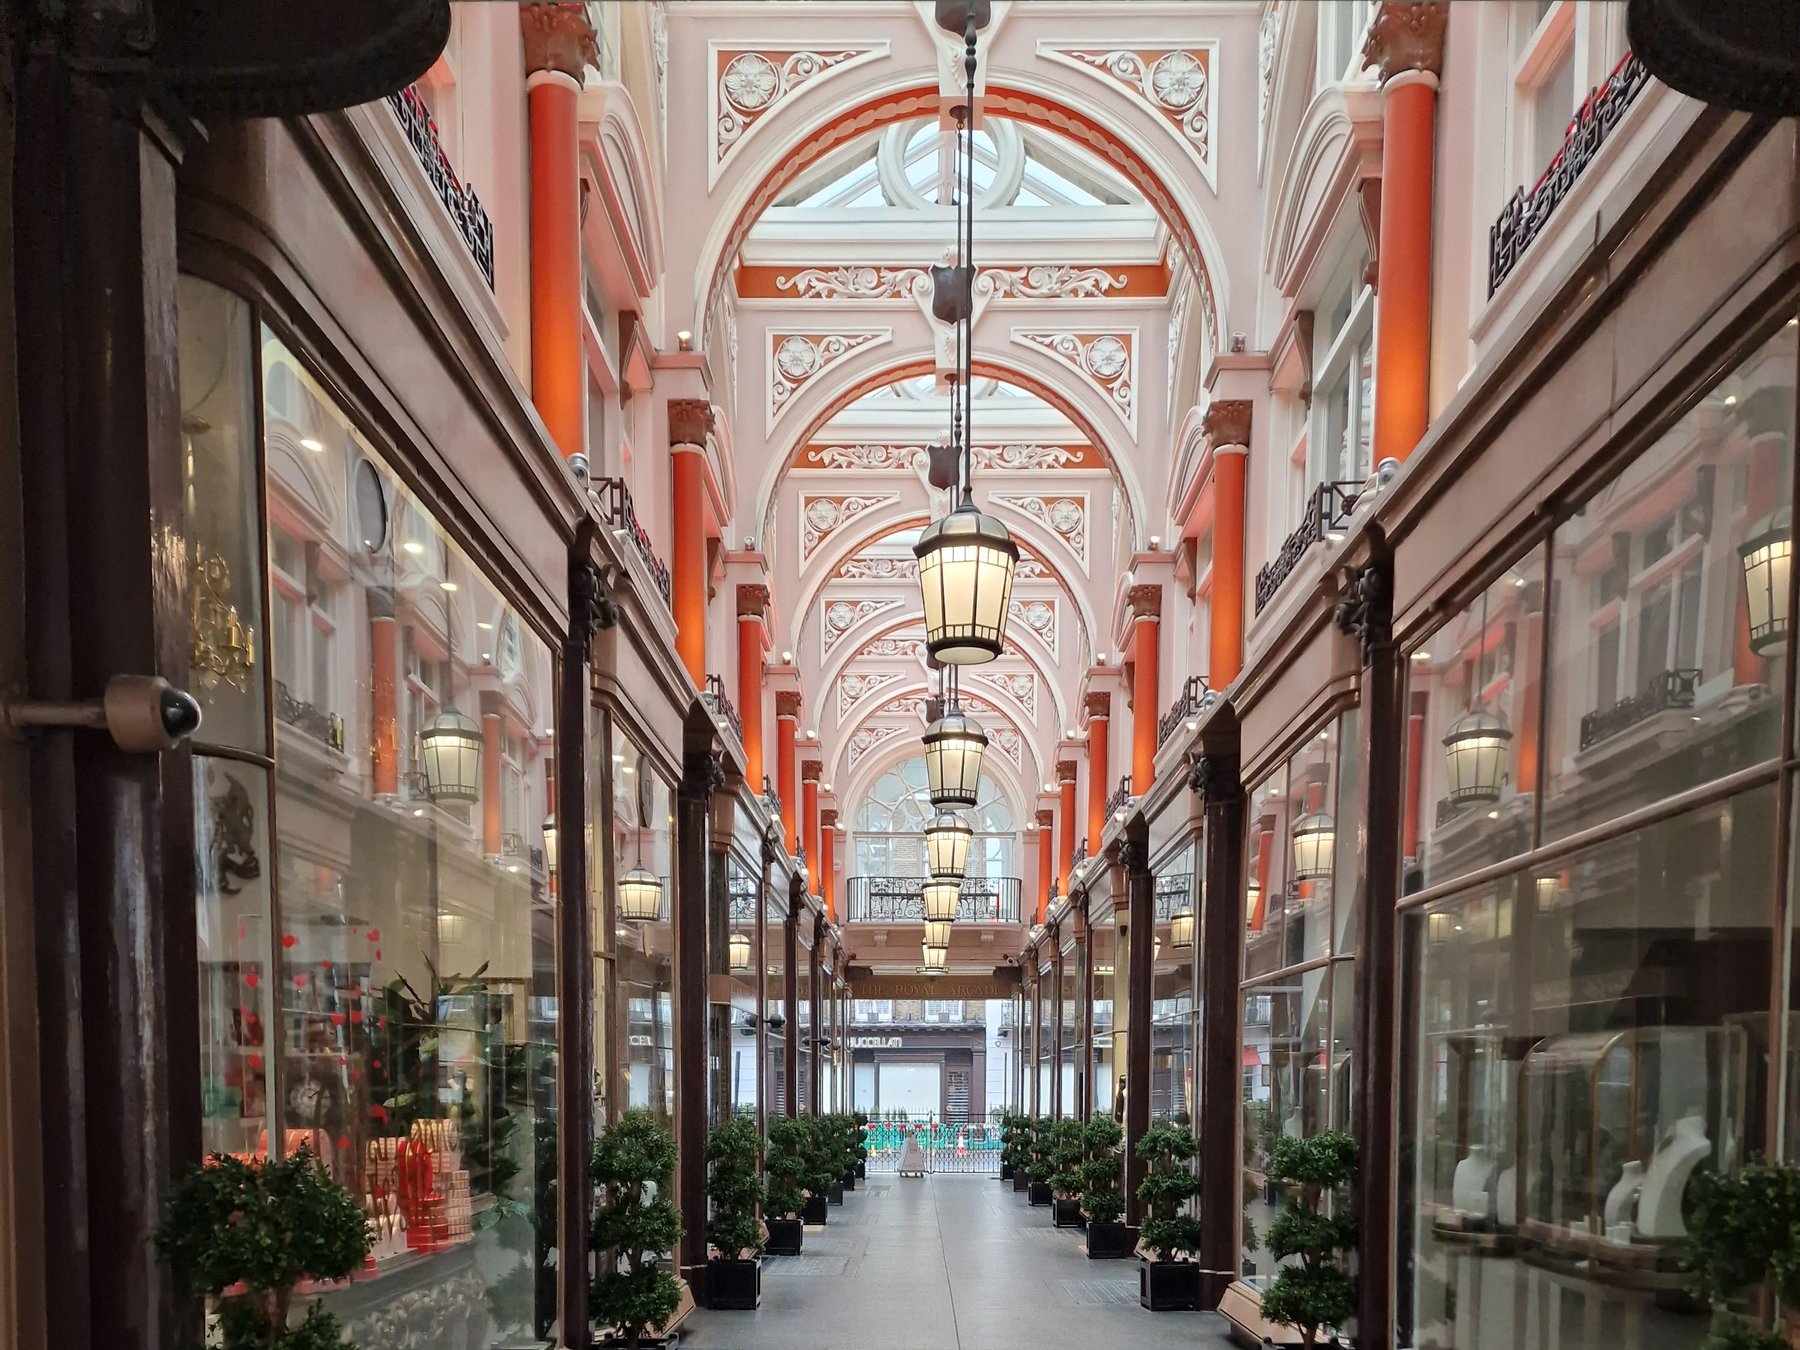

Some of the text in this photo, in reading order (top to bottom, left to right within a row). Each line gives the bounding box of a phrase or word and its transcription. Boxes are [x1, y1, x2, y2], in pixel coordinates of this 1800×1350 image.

[861, 984, 1000, 995] THE ROYAL ARCADE
